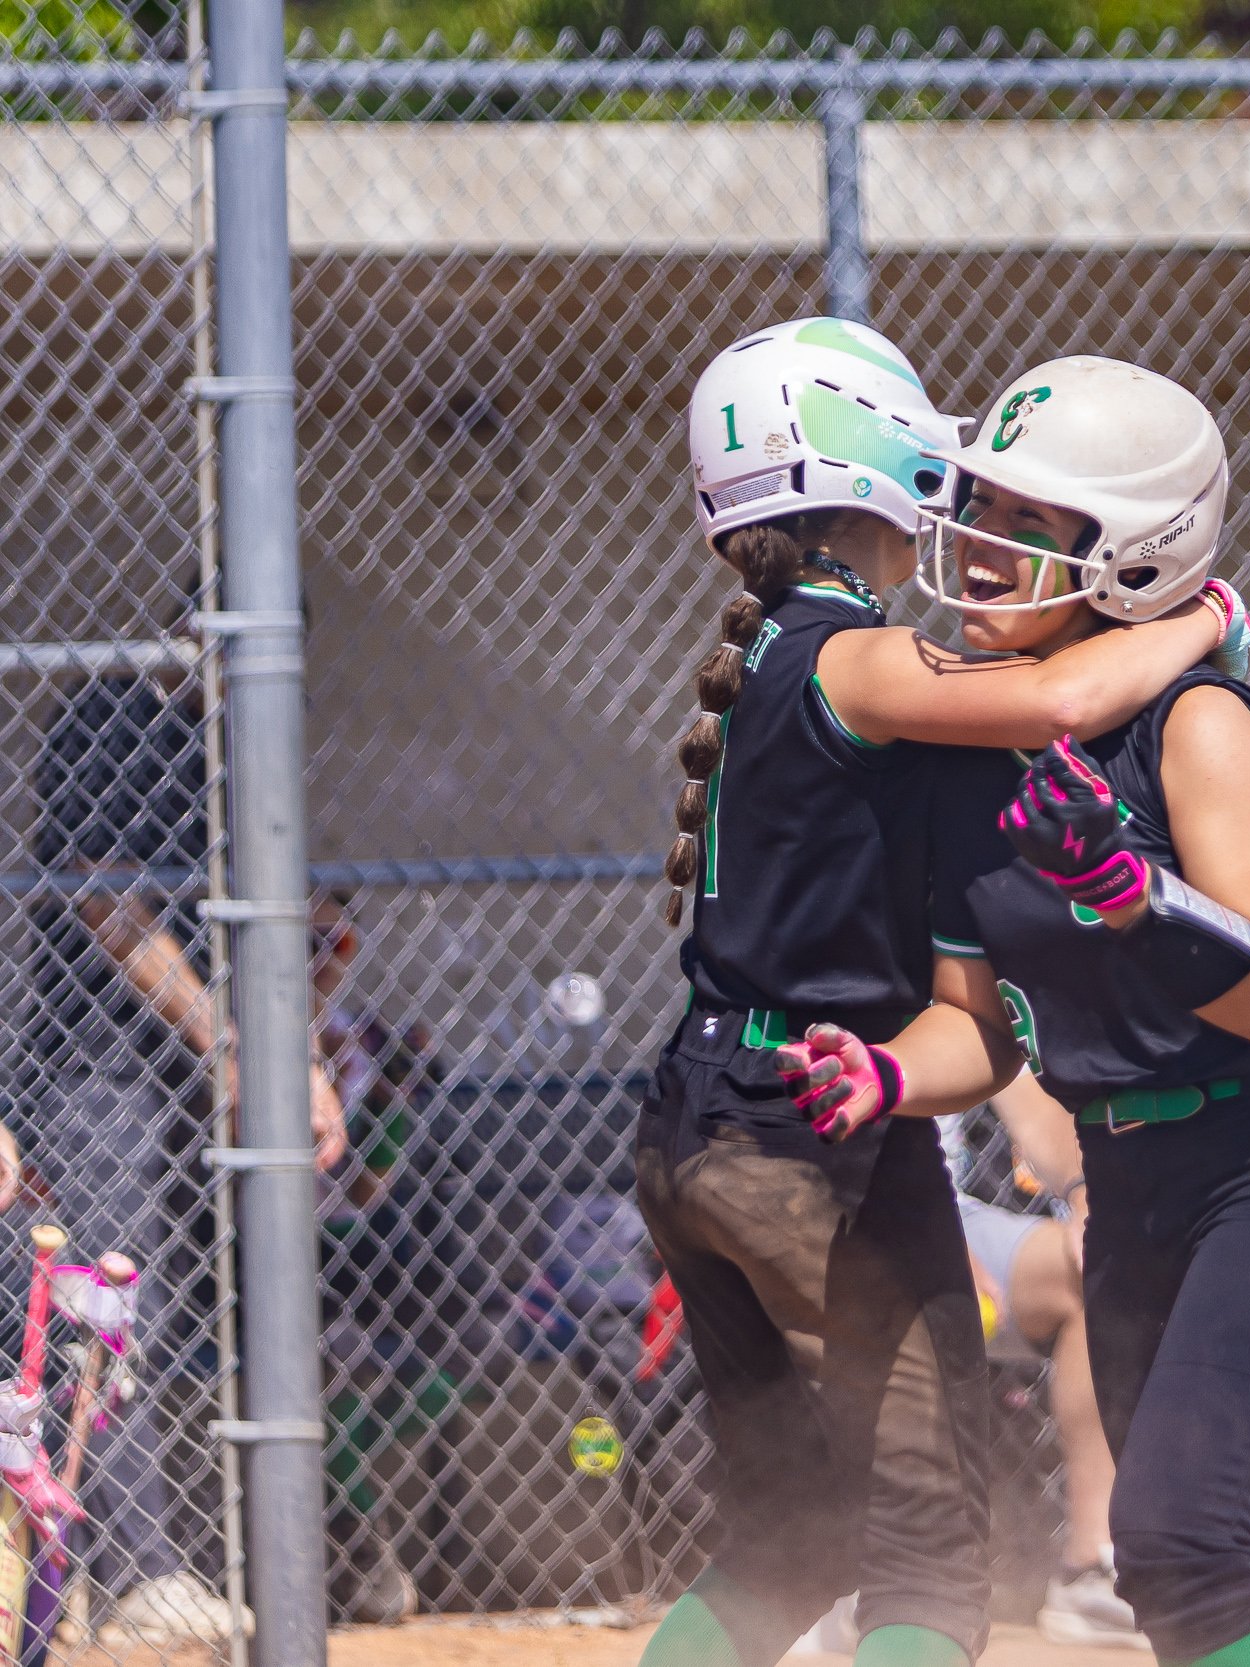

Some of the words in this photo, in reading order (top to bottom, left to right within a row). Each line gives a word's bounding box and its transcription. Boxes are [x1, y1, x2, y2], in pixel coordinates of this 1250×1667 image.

[721, 402, 744, 453] 1
[1159, 514, 1195, 549] RIP-IT
[1107, 867, 1130, 888] BOLT
